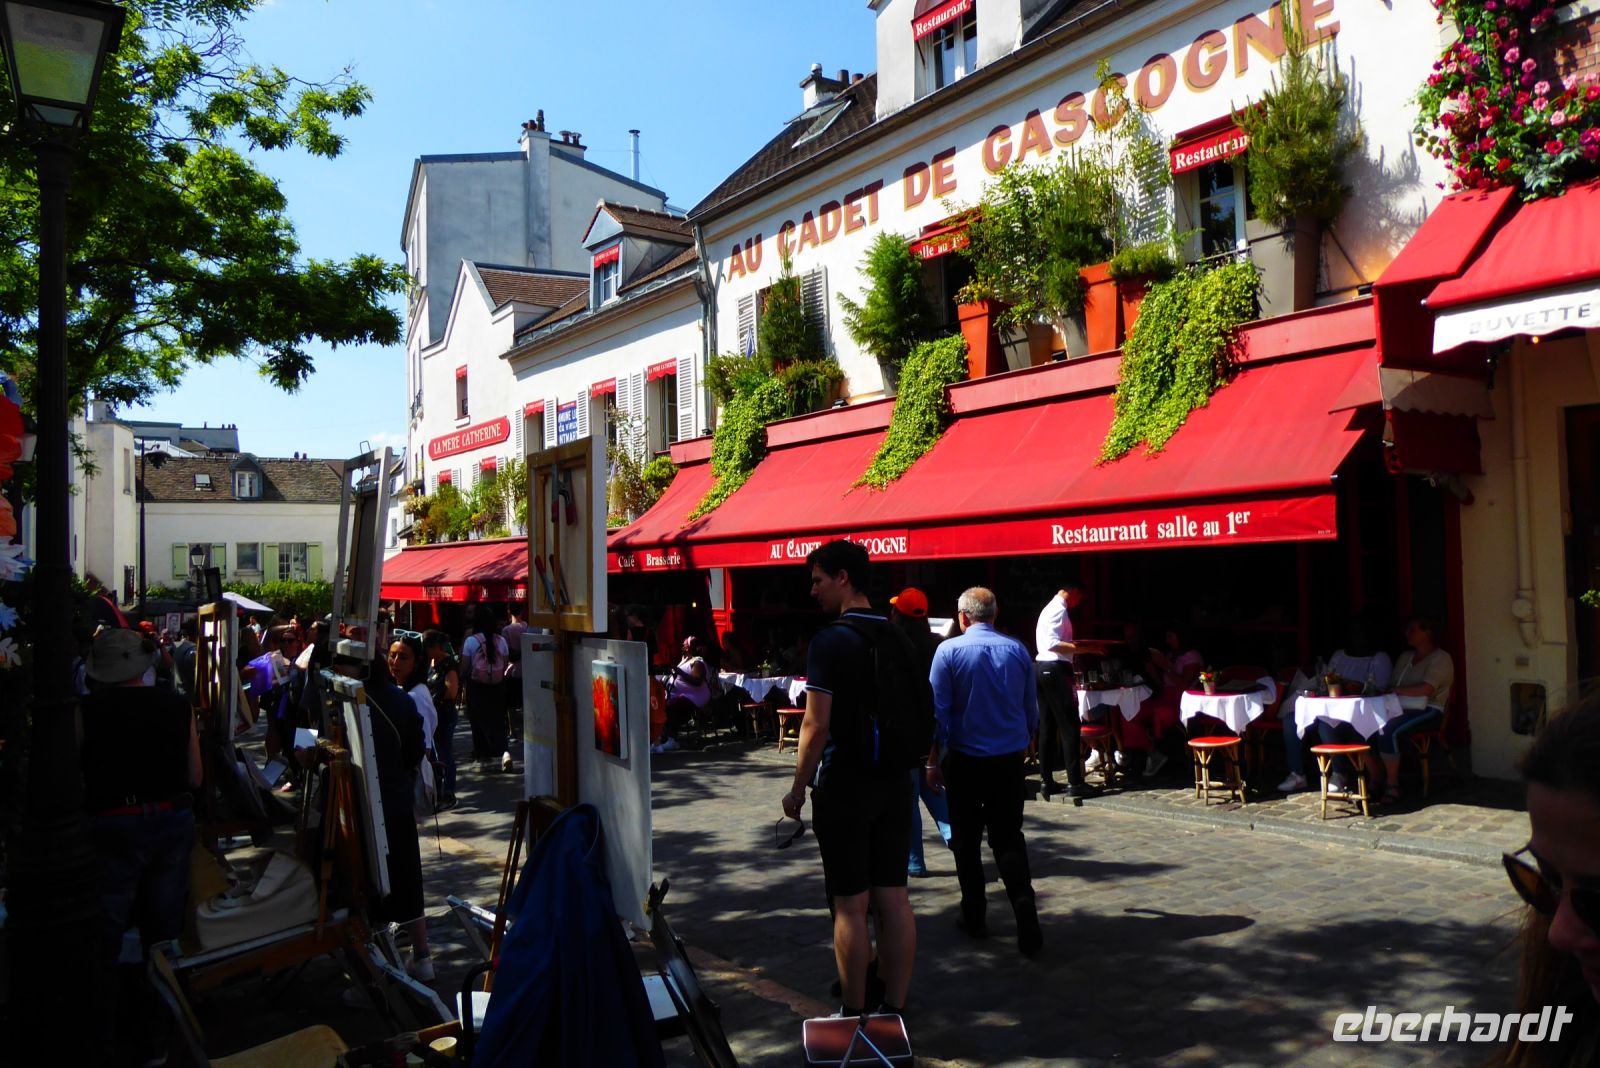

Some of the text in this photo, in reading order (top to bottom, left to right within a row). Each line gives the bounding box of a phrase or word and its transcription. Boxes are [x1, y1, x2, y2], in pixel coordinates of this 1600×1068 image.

[915, 0, 968, 37] Restaurant
[728, 0, 1341, 283] AU CADET DE GASCOGNE
[1175, 135, 1250, 170] Restauran
[1469, 302, 1592, 336] BUVETTE
[433, 422, 501, 454] LA MERE CATHERINE
[1051, 510, 1250, 545] Restaurant salle au 1er
[618, 551, 681, 568] Café Brasserie
[770, 543, 784, 559] AU
